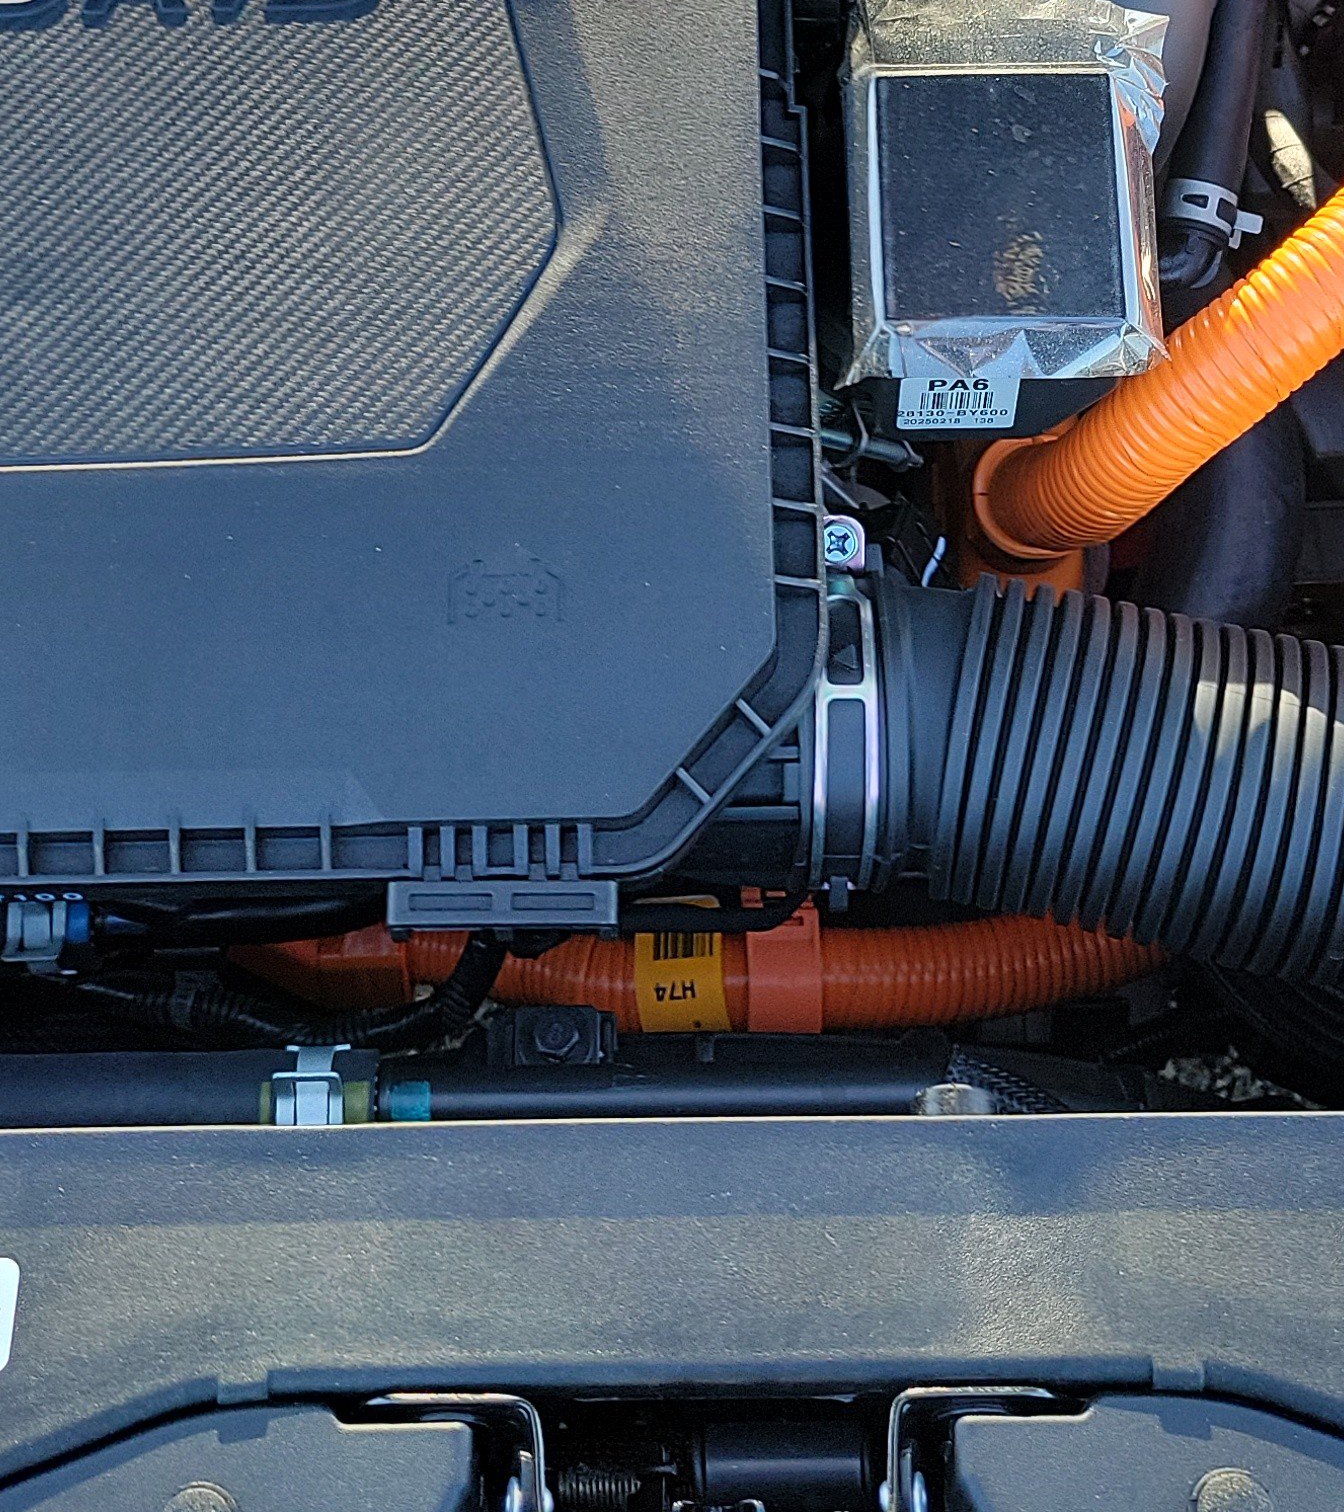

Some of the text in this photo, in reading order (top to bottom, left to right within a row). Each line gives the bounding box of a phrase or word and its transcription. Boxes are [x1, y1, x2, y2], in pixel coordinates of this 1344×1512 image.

[927, 378, 990, 392] PA6
[897, 408, 1009, 418] 28130-BY600
[654, 978, 696, 1003] H74
